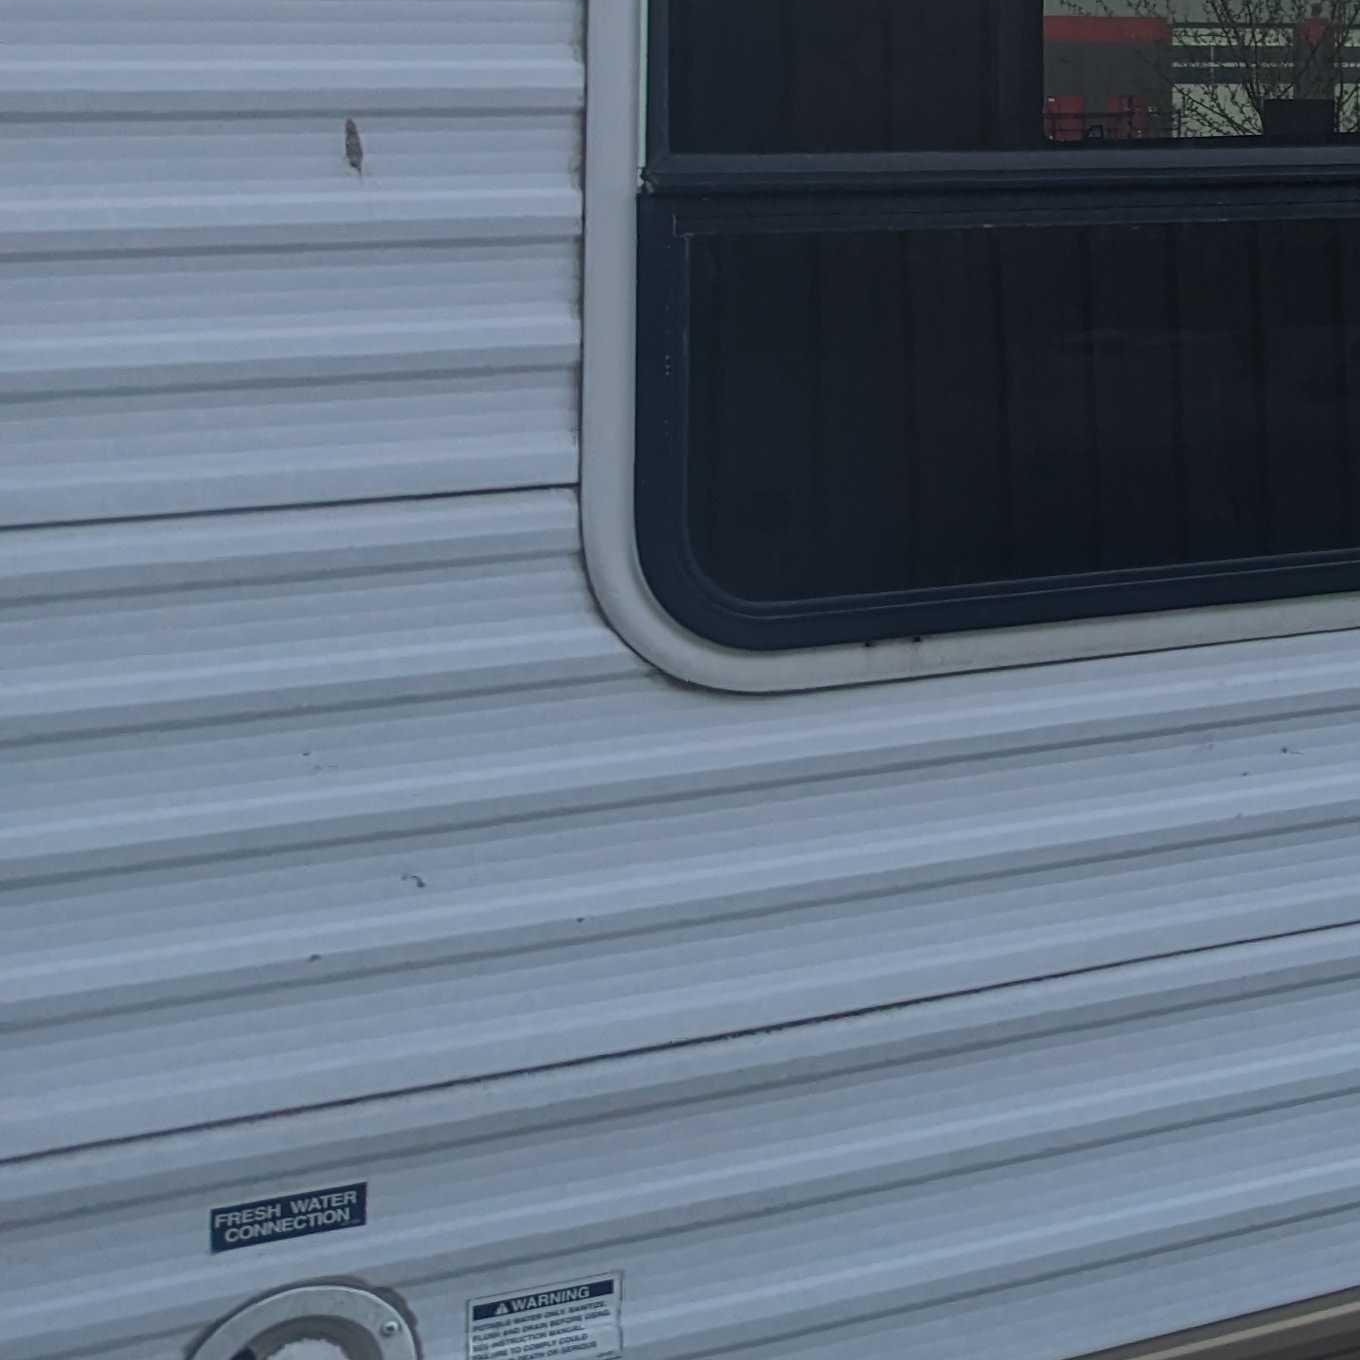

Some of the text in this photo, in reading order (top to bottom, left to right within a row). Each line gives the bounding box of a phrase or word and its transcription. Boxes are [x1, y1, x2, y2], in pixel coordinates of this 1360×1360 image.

[214, 1190, 357, 1228] FRESH WATER
[224, 1208, 350, 1242] CONNECTION
[511, 1286, 590, 1312] WARNING
